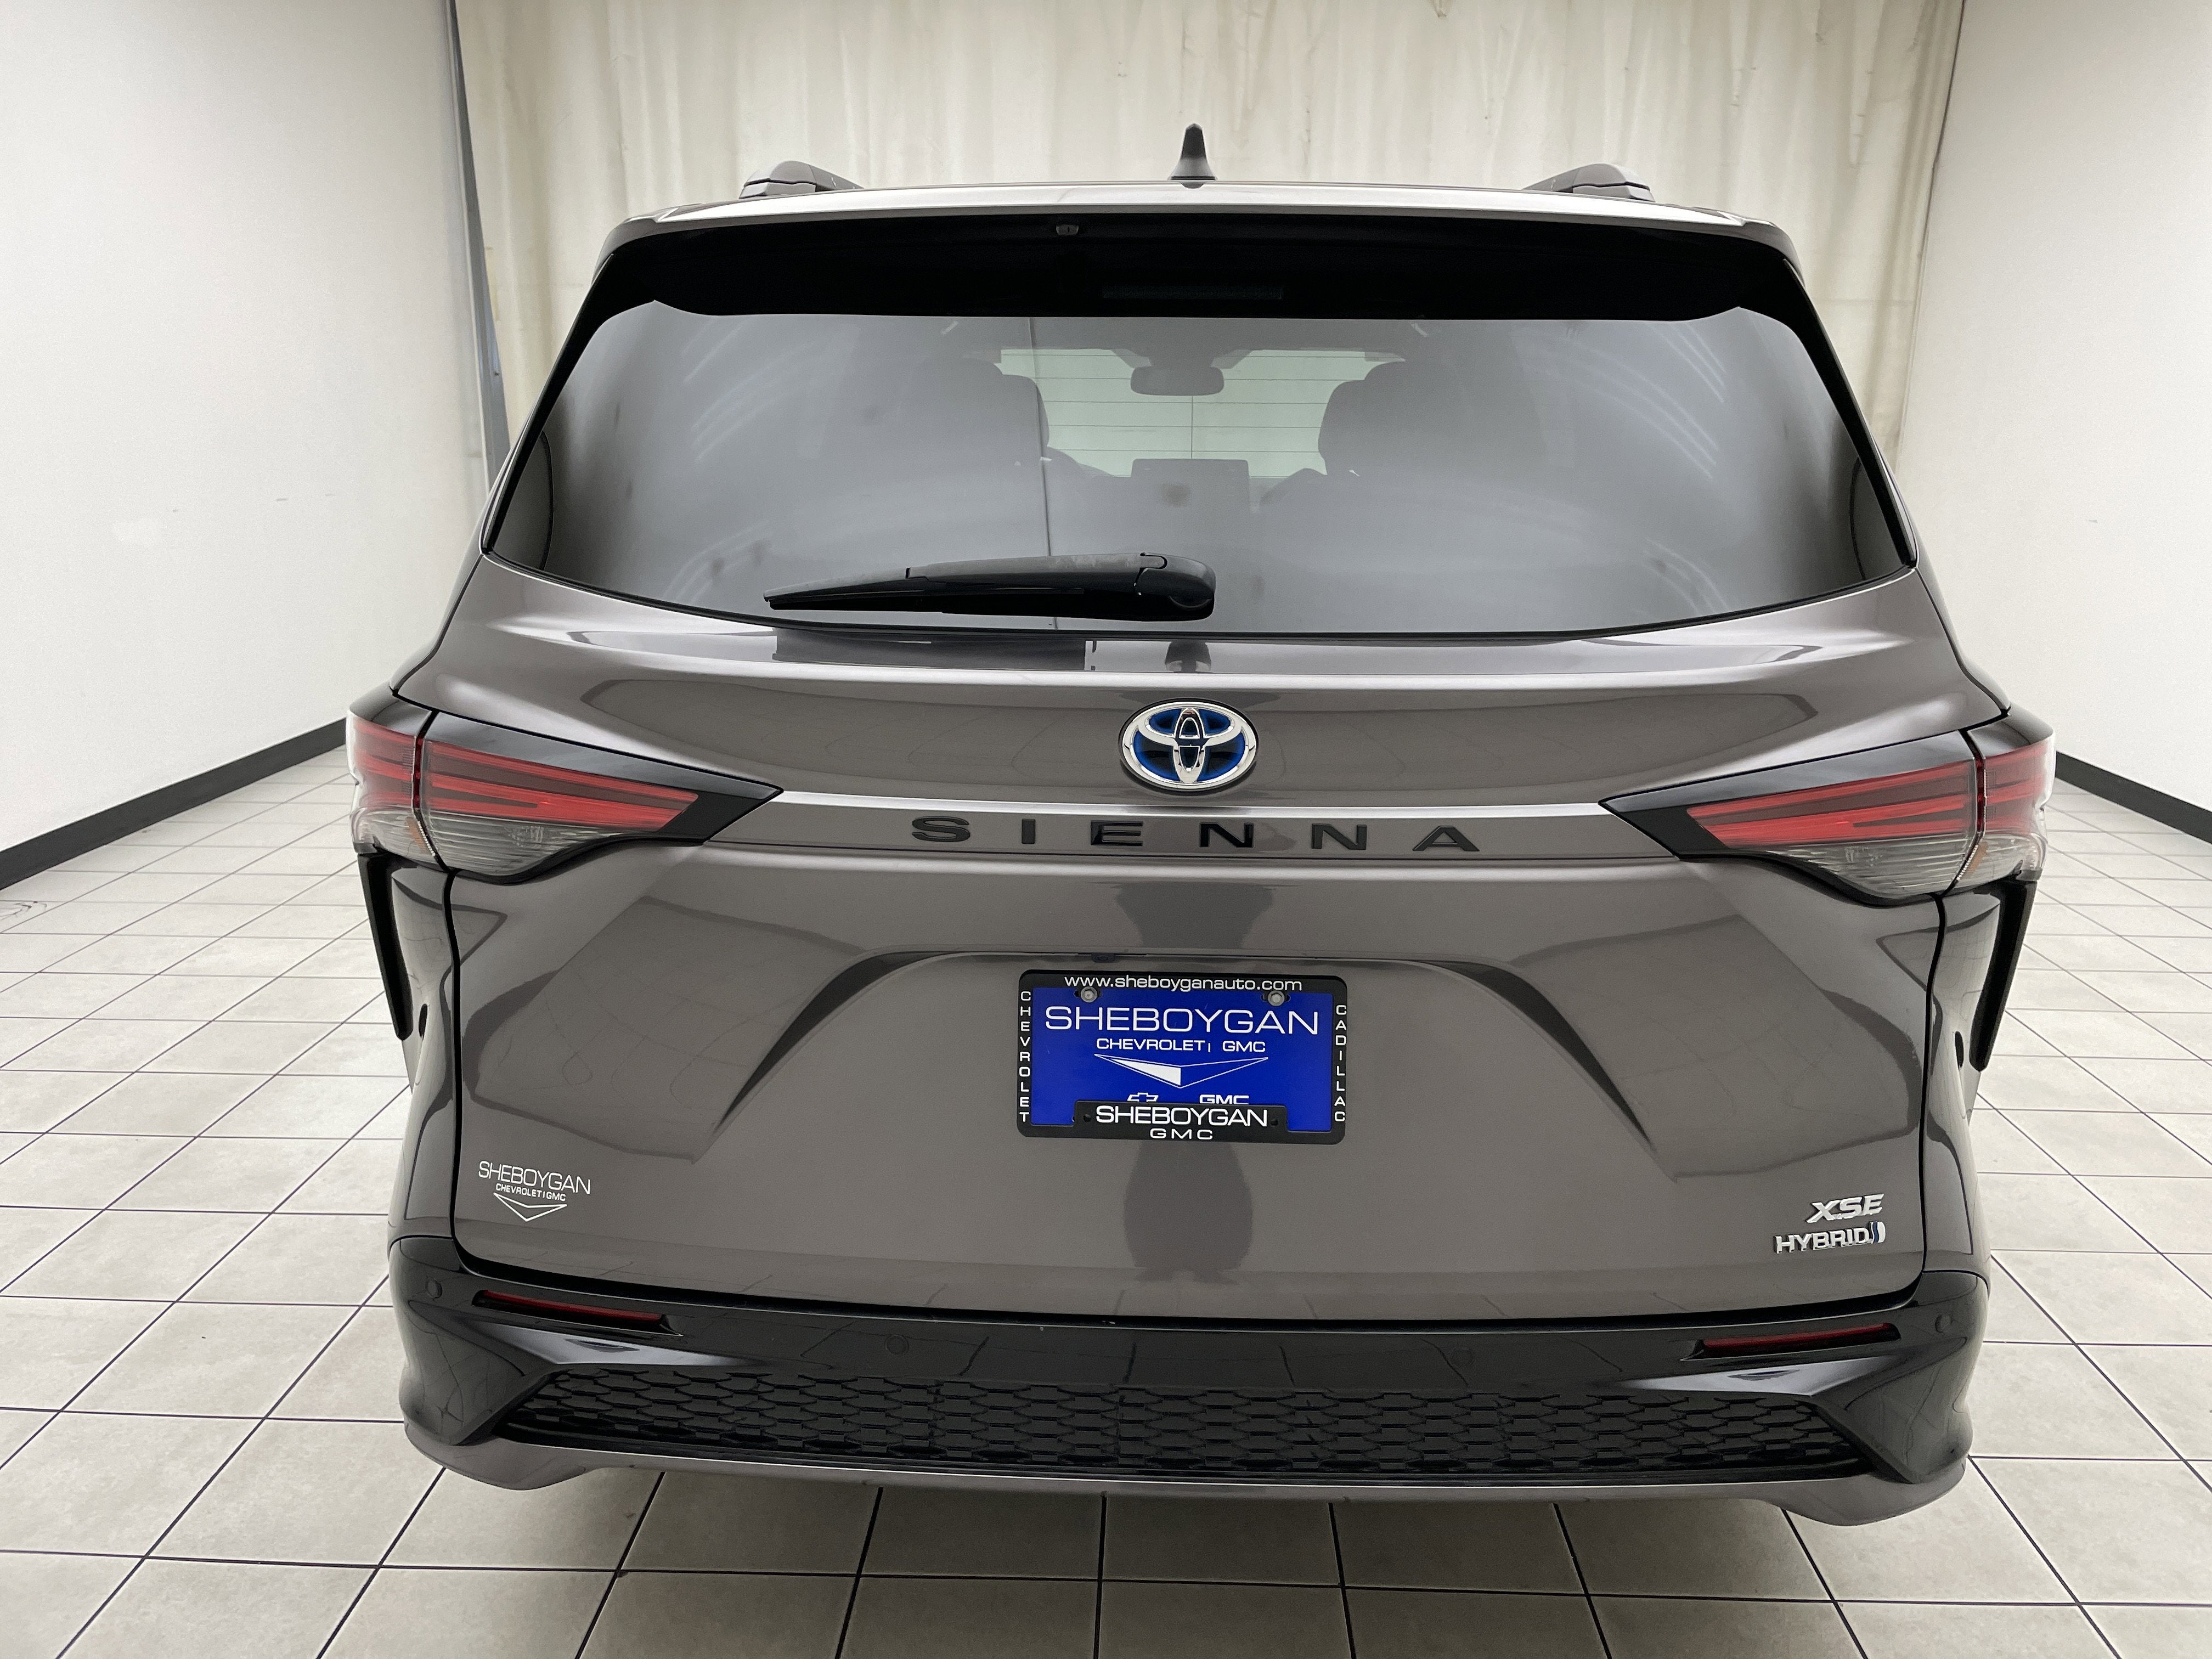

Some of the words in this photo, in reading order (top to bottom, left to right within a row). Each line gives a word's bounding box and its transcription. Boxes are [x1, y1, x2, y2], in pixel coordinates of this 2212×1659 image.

[911, 815, 1480, 851] SIENNA
[1064, 974, 1302, 992] www.sheboyganauto.com
[1045, 1006, 1318, 1035] SHEBOYGAN
[1019, 991, 1031, 1122] CHEVROLET
[1096, 1038, 1206, 1051] CHEVROLET
[1222, 1040, 1266, 1053] GMC
[1334, 1005, 1347, 1122] CADILLAC
[1199, 1094, 1249, 1105] GMC
[1096, 1105, 1267, 1127] SHEBOYGAN
[1150, 1128, 1213, 1140] GMC
[478, 1160, 591, 1195] SHEBOYGAN
[1806, 1193, 1884, 1223] XSE
[1774, 1227, 1871, 1254] HYBRID
